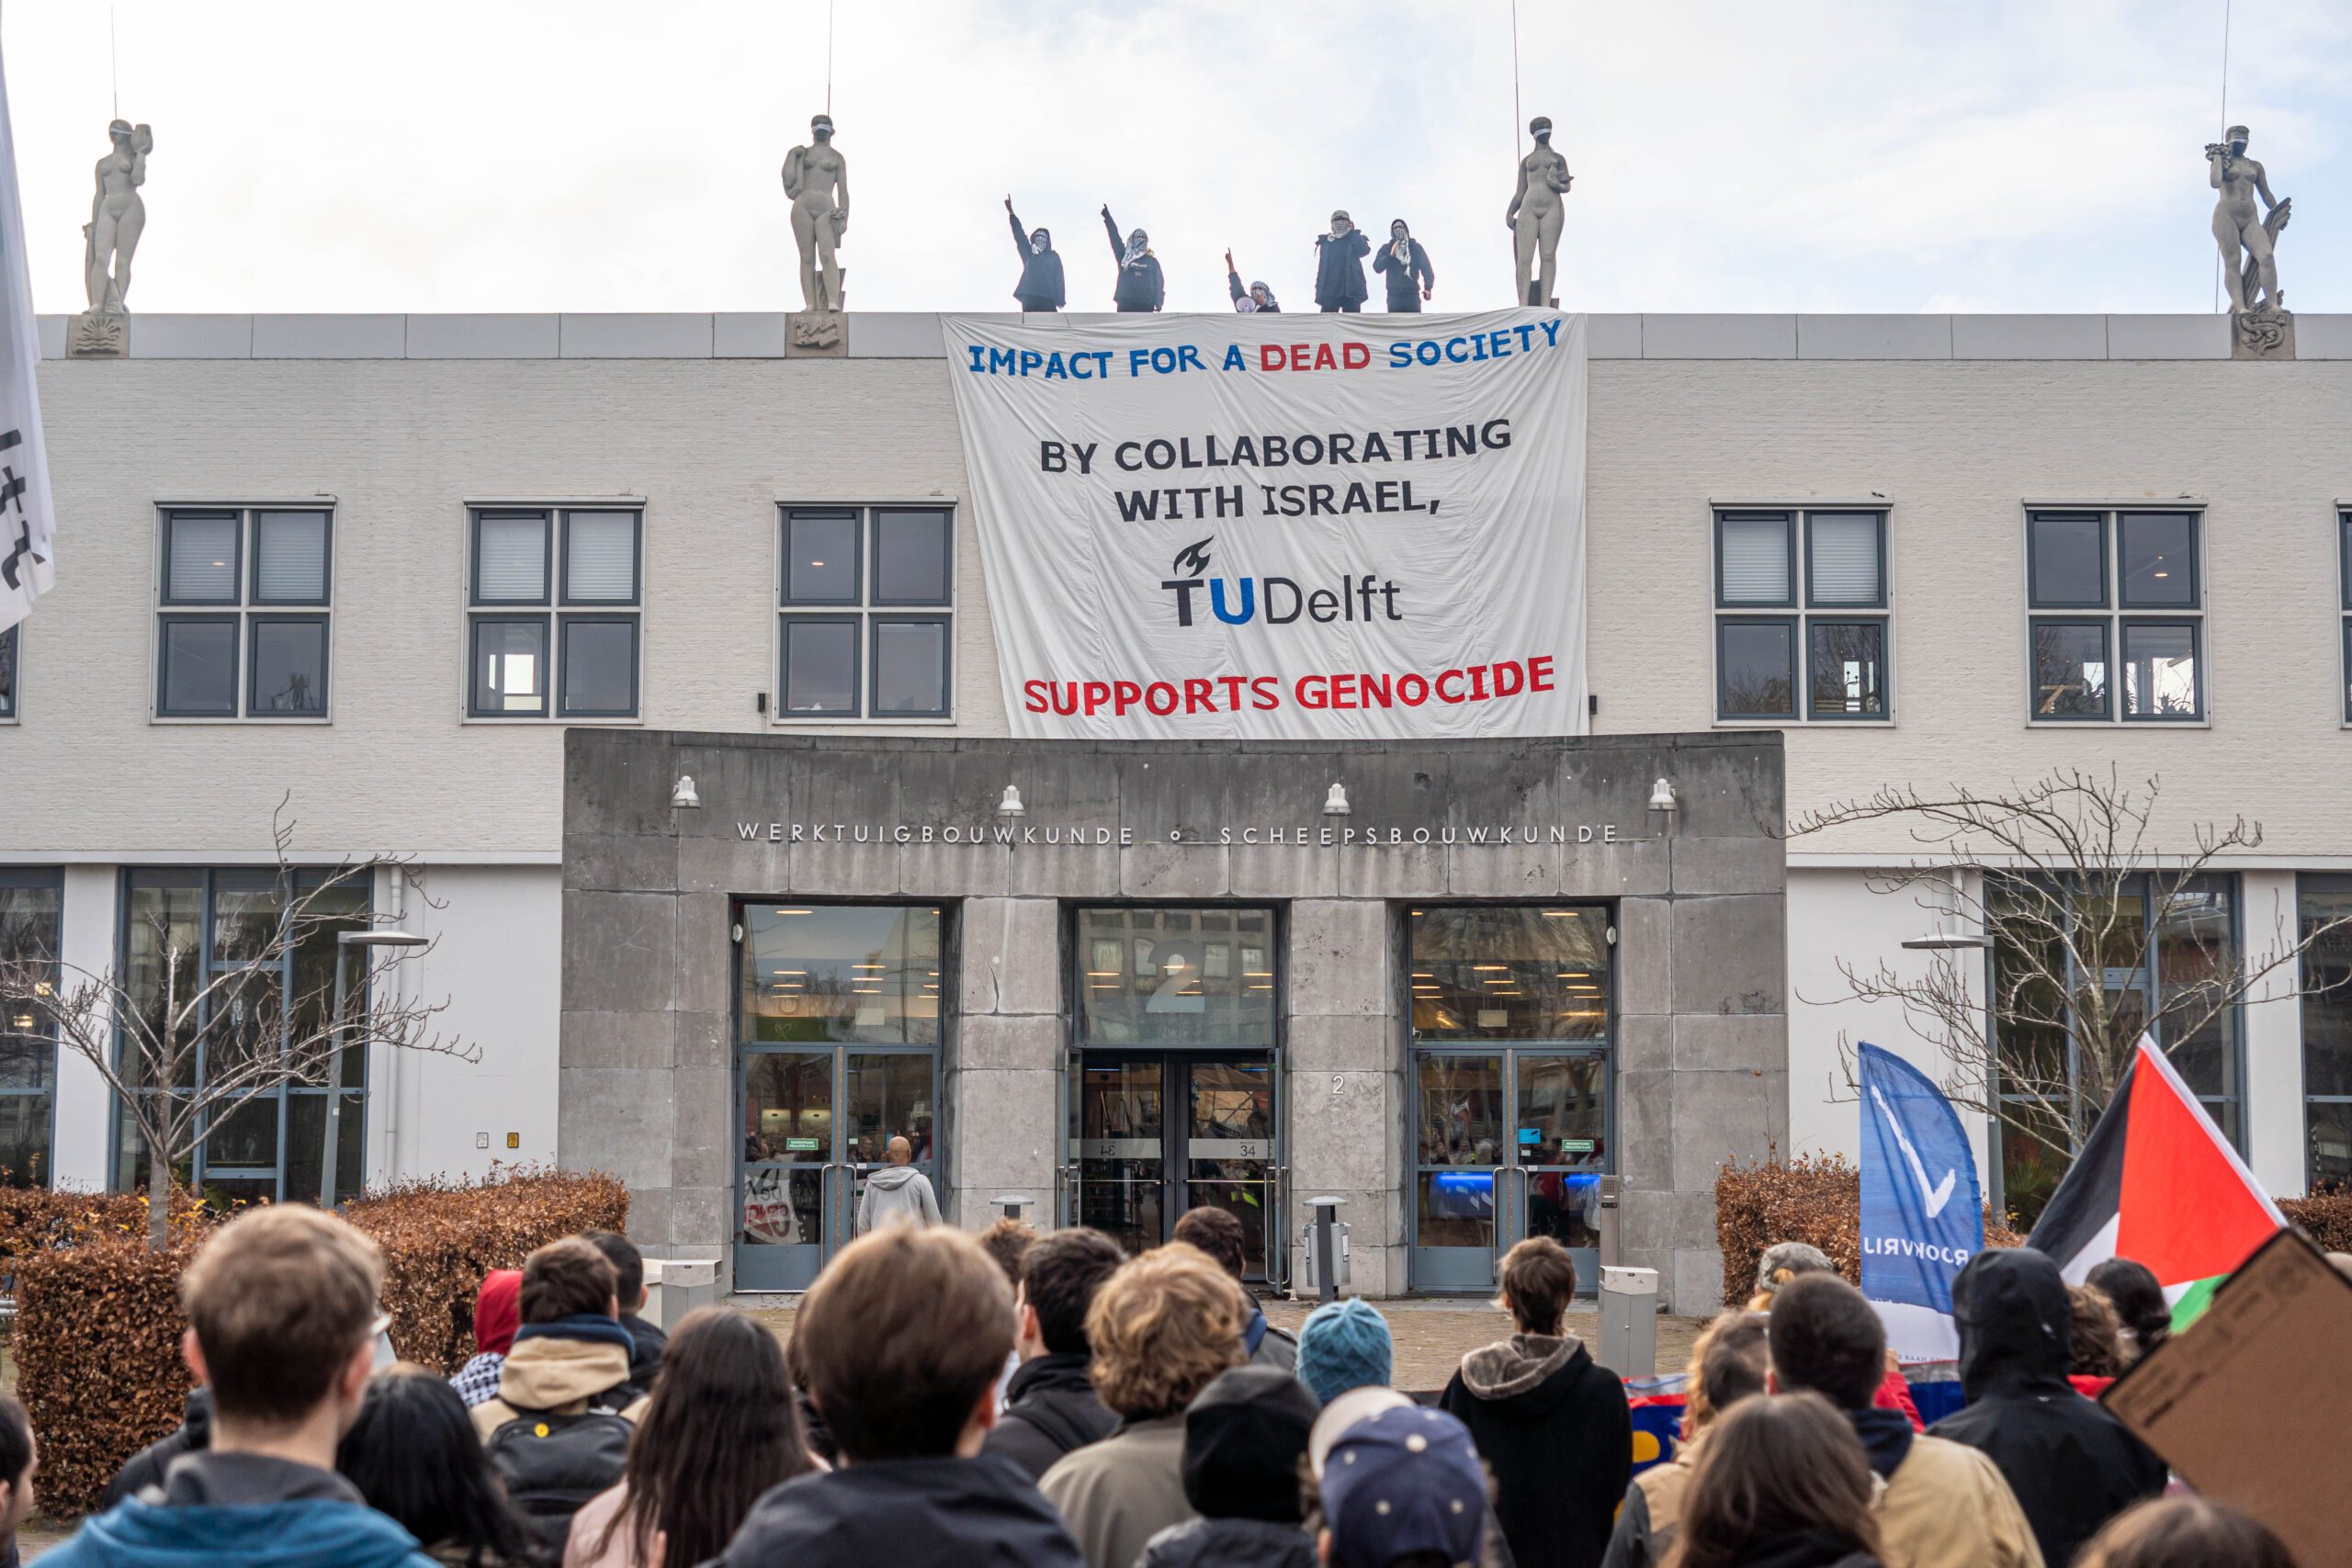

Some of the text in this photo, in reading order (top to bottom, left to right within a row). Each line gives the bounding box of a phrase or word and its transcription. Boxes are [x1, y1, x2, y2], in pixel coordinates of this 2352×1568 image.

[968, 319, 1561, 379] IMPACT FOR A DEAD SOCIETY
[1041, 418, 1511, 475] BY COLLABORATING
[1114, 480, 1441, 523] WITH ISRAEL,
[1024, 655, 1555, 716] SUPPORTS GENOCIDE
[737, 821, 1619, 846] WERKTUIGBOUWKUNDE SCHEEPSBOUWKUNDE
[1146, 939, 1205, 1013] 2
[1331, 1075, 1345, 1095] 2
[1240, 1145, 1256, 1156] 34
